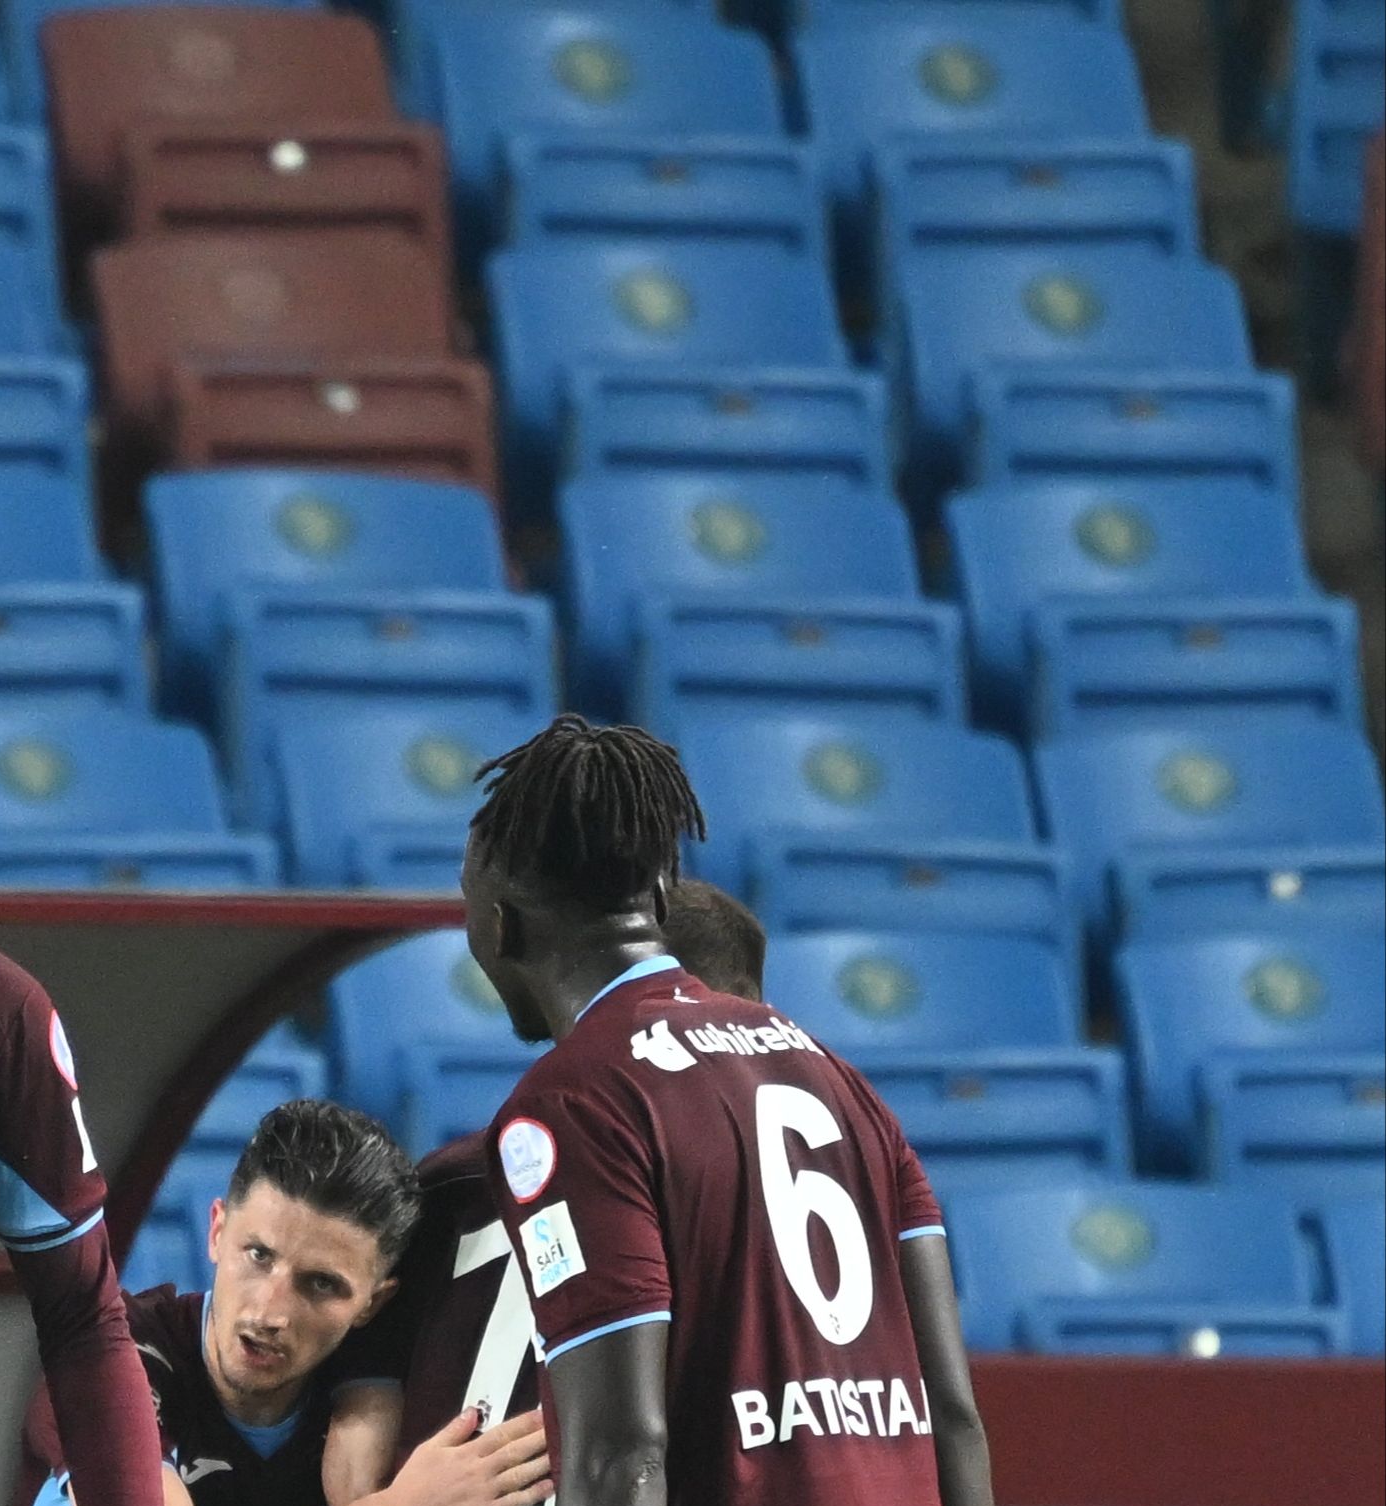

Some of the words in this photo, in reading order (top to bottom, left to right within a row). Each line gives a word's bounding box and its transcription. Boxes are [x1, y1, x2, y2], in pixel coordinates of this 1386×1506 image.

[755, 1083, 874, 1346] 6
[453, 1218, 546, 1434] 7
[731, 1377, 933, 1450] BATISTA.
